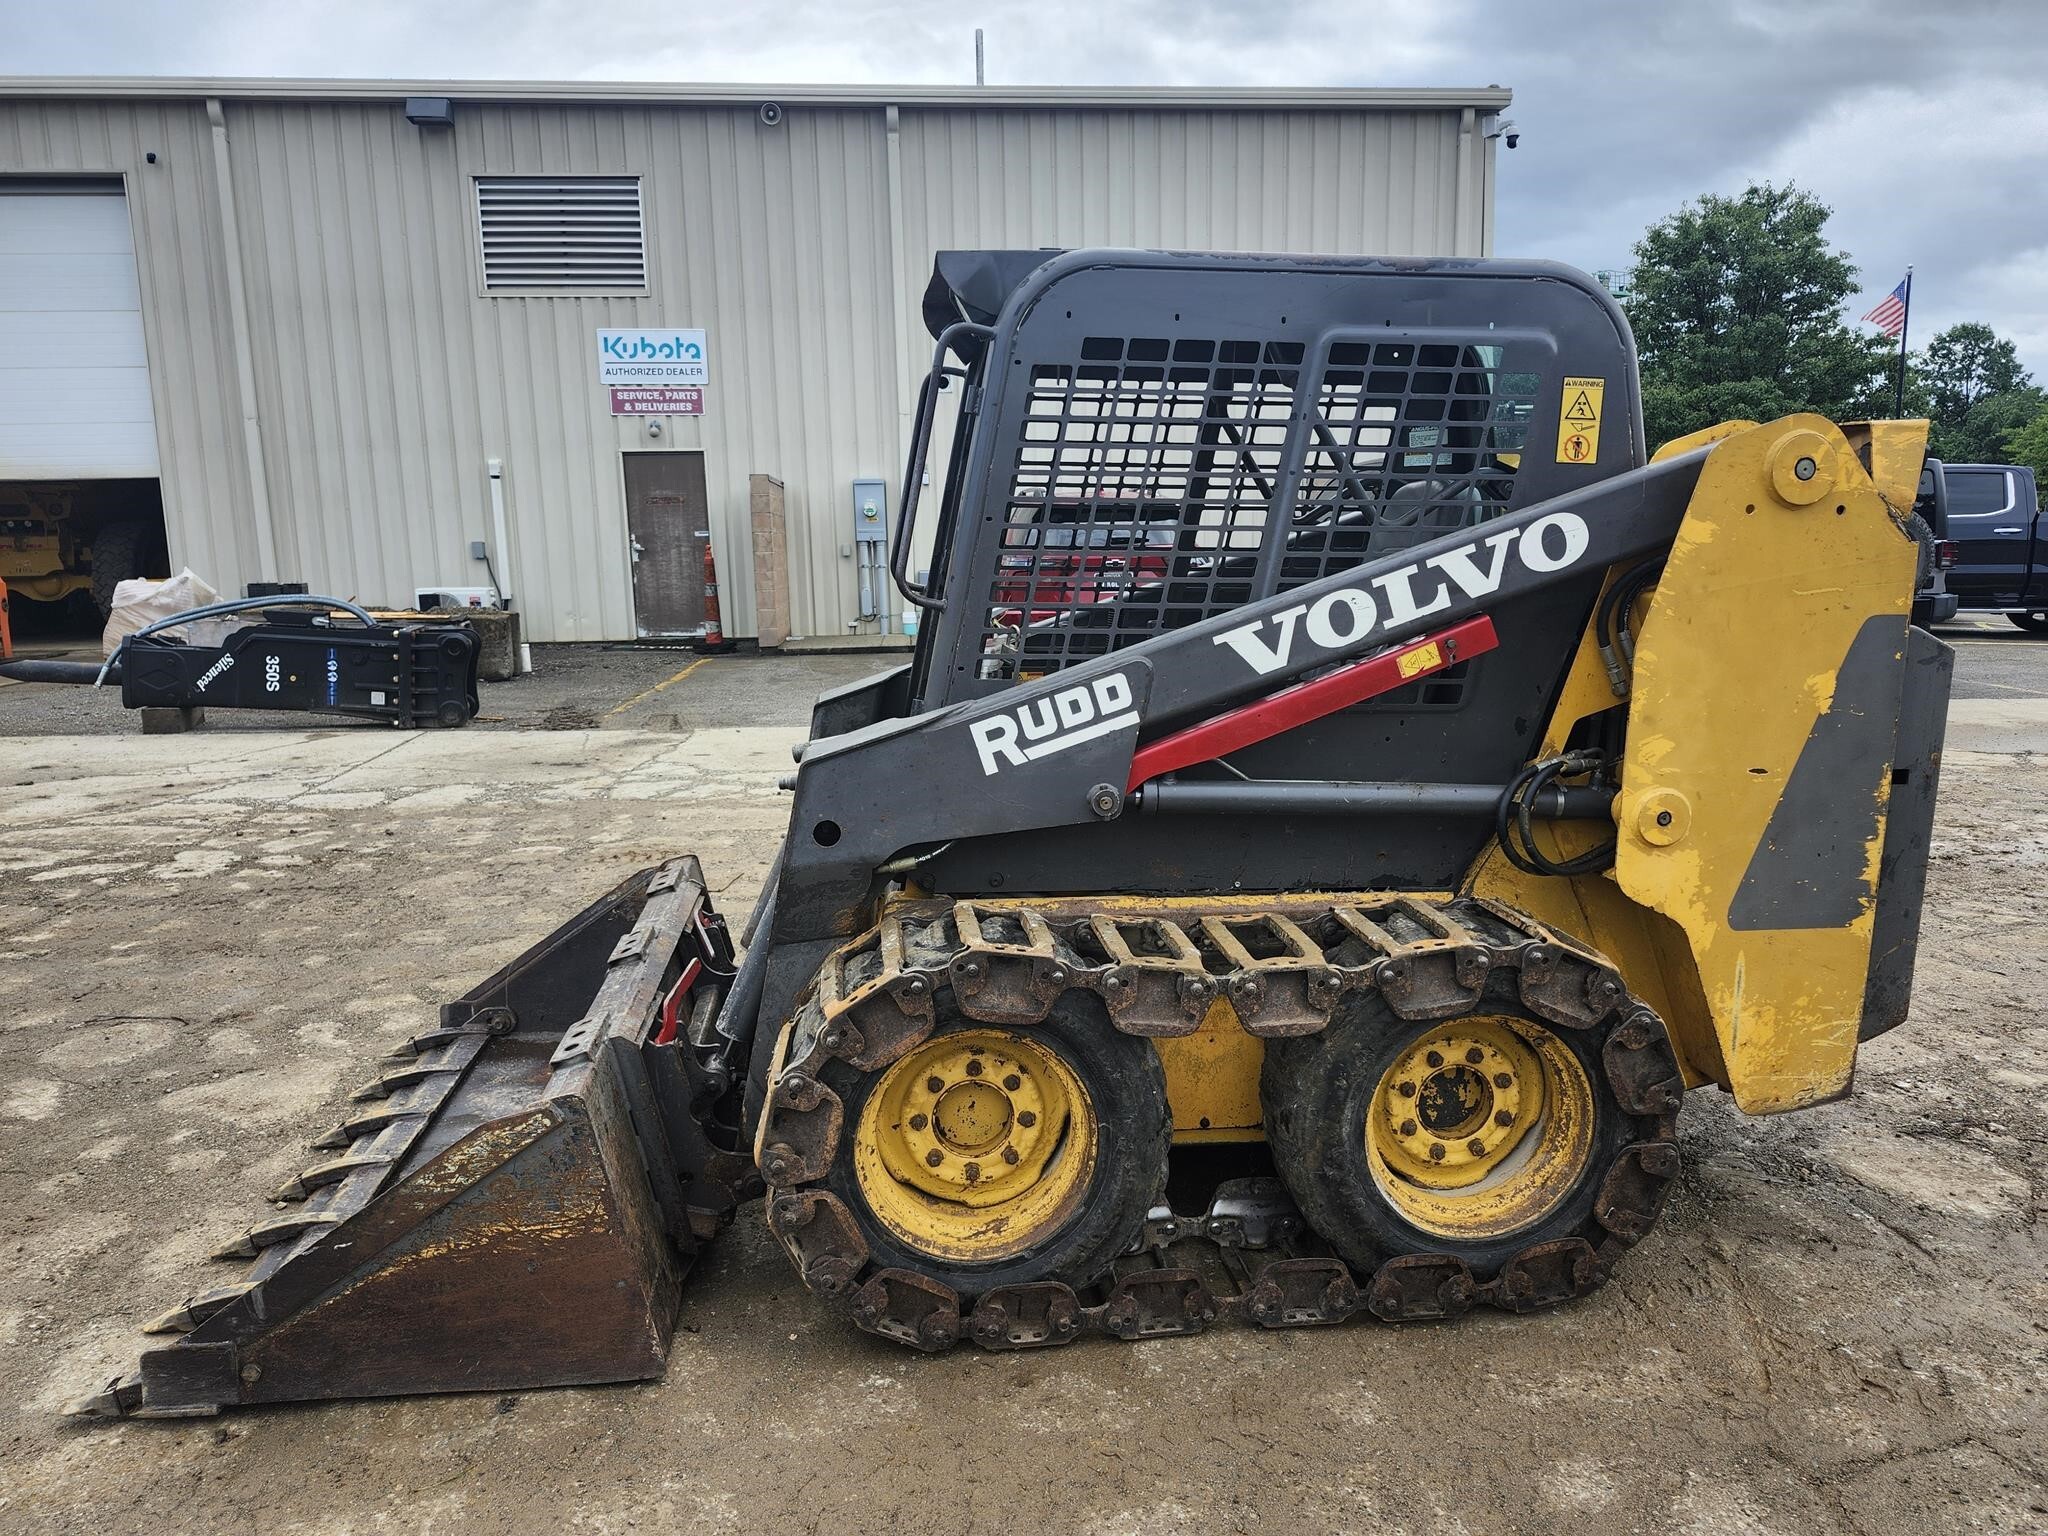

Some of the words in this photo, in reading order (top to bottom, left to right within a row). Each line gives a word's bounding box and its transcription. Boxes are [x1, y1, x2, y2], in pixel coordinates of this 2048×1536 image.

[603, 336, 701, 359] Kubota
[605, 367, 664, 376] AUTHORIZED
[666, 367, 703, 376] DEALER
[1571, 379, 1604, 388] WARNING
[616, 391, 663, 401] SERVICE,
[665, 391, 698, 400] PARTS
[624, 402, 633, 411] &
[634, 402, 692, 411] DELIVERIES
[1213, 511, 1590, 676] VOLVO
[196, 652, 235, 692] Silenced
[265, 655, 280, 692] 350S
[968, 671, 1133, 776] RUDD
